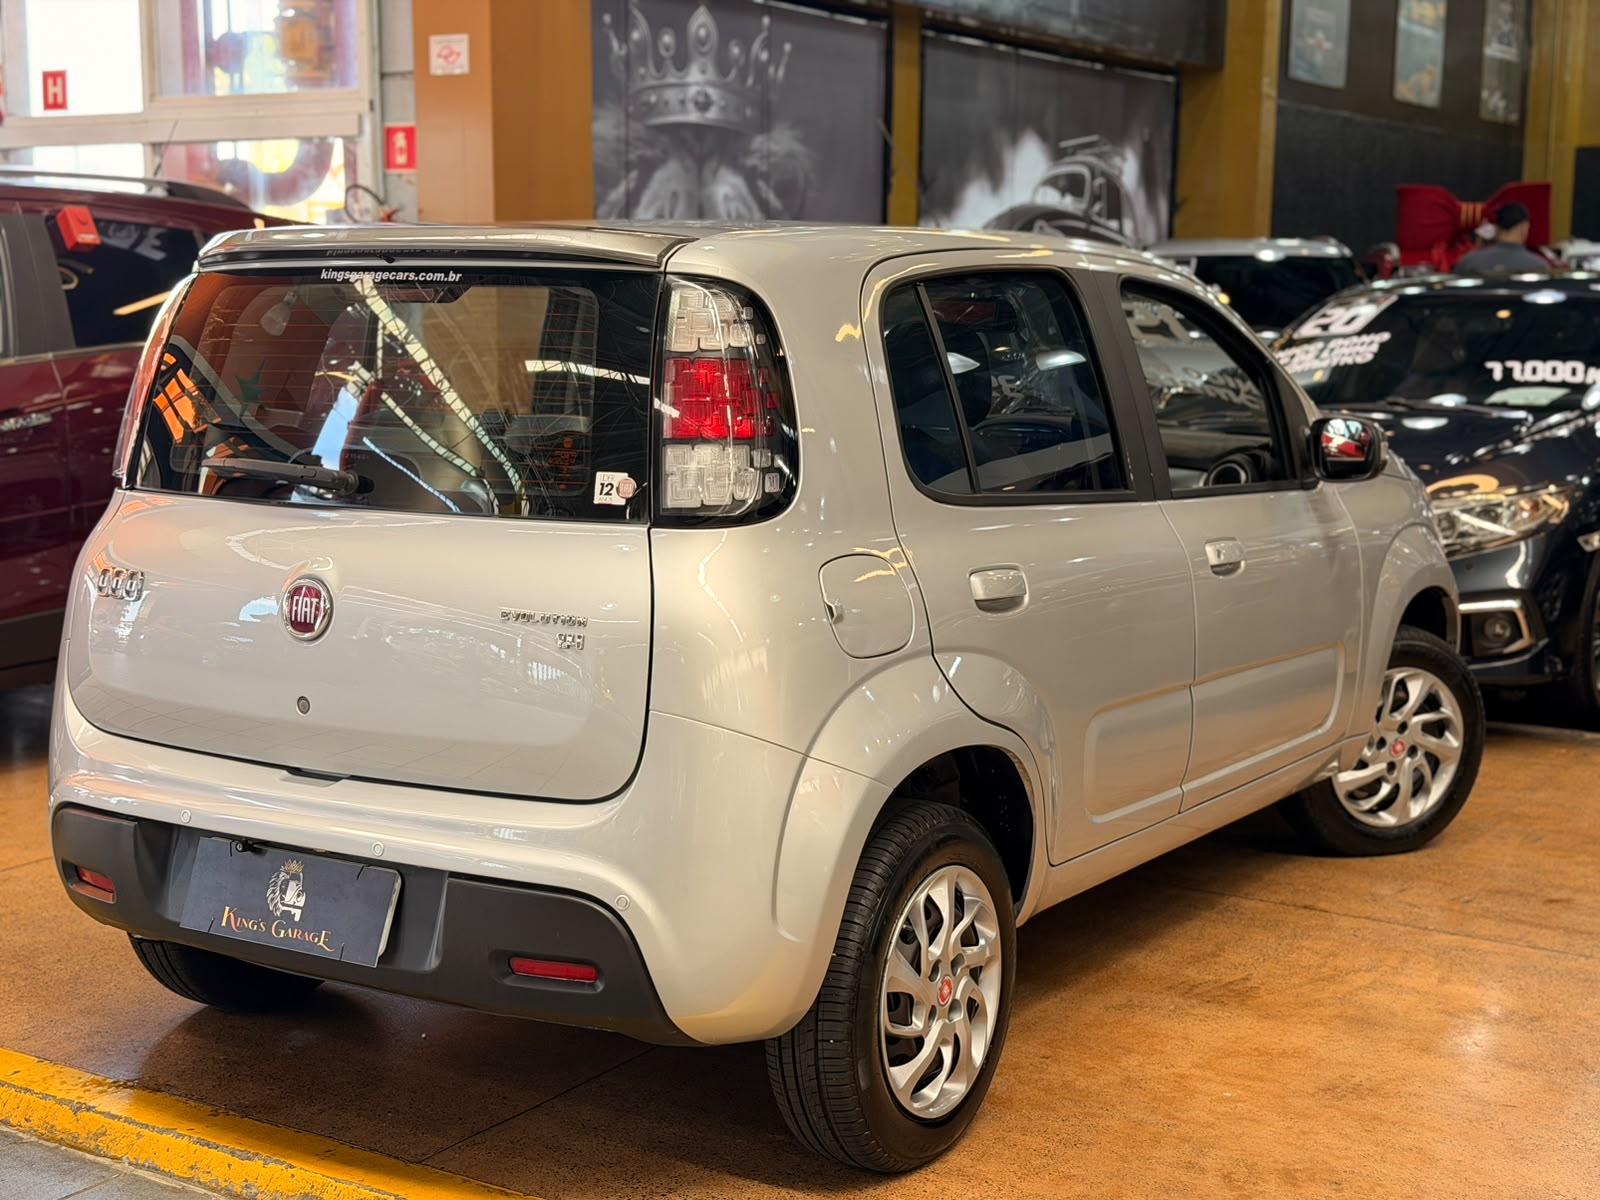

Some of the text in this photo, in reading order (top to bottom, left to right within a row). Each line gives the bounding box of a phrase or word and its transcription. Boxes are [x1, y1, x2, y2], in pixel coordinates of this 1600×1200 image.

[47, 77, 63, 104] H
[320, 269, 462, 282] kingsgaragecars.com.br
[599, 482, 614, 496] 12
[291, 596, 320, 624] FIAT
[500, 609, 588, 628] EVOLUTION
